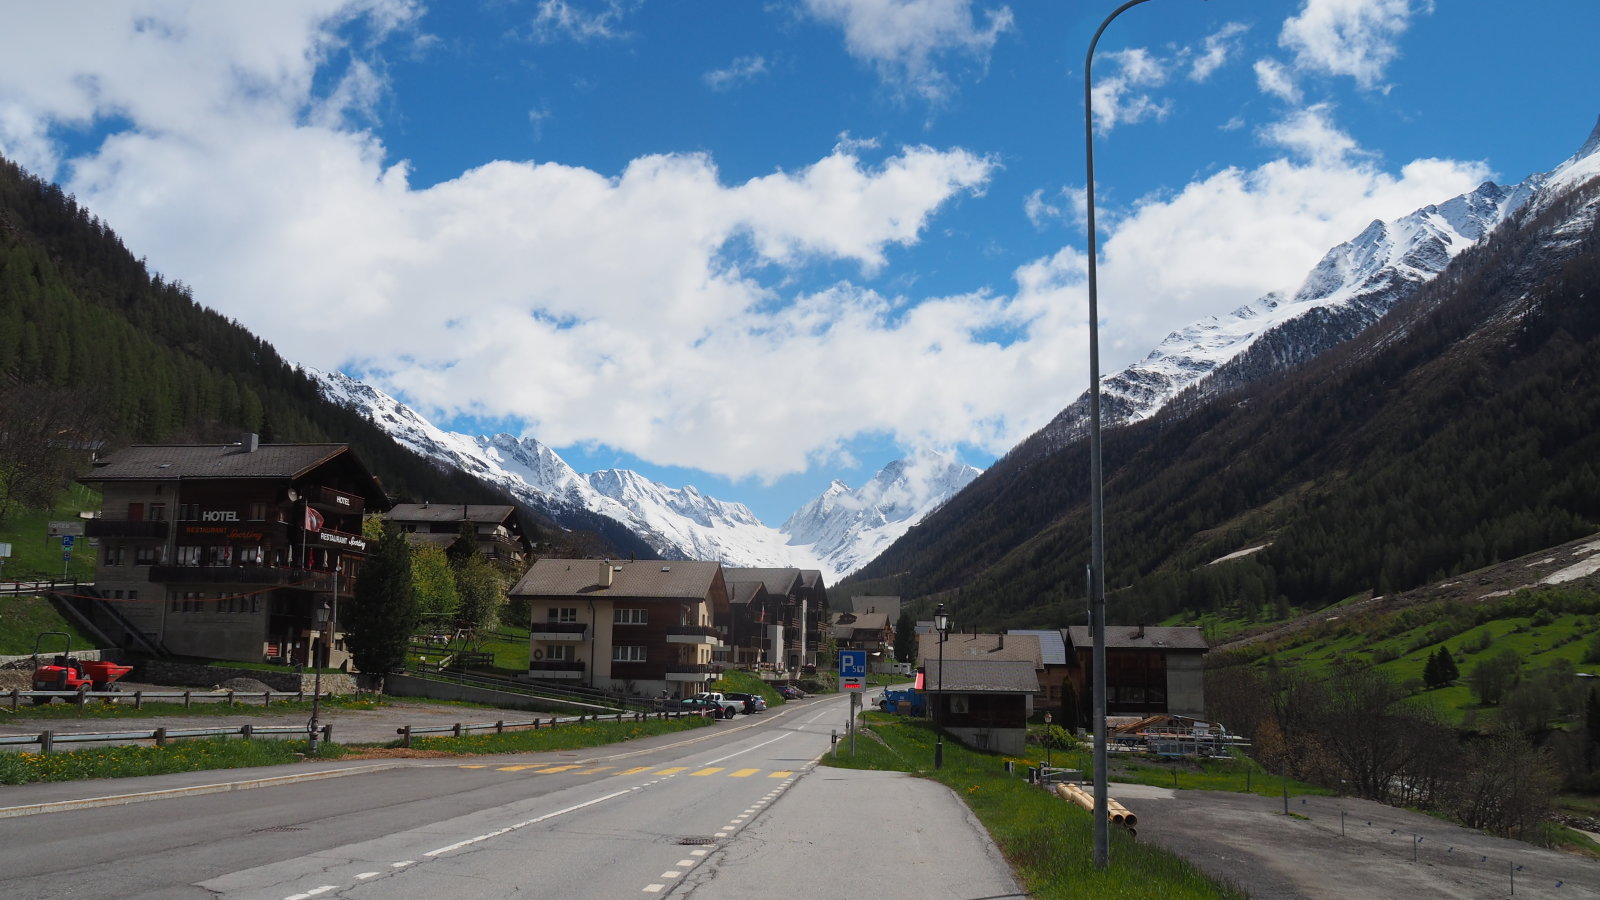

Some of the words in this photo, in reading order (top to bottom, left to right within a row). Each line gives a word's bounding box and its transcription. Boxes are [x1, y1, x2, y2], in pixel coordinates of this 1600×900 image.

[336, 496, 350, 506] HOTEL
[202, 511, 240, 521] HOTEL
[320, 532, 348, 544] RESTAURANT
[842, 655, 854, 672] P
